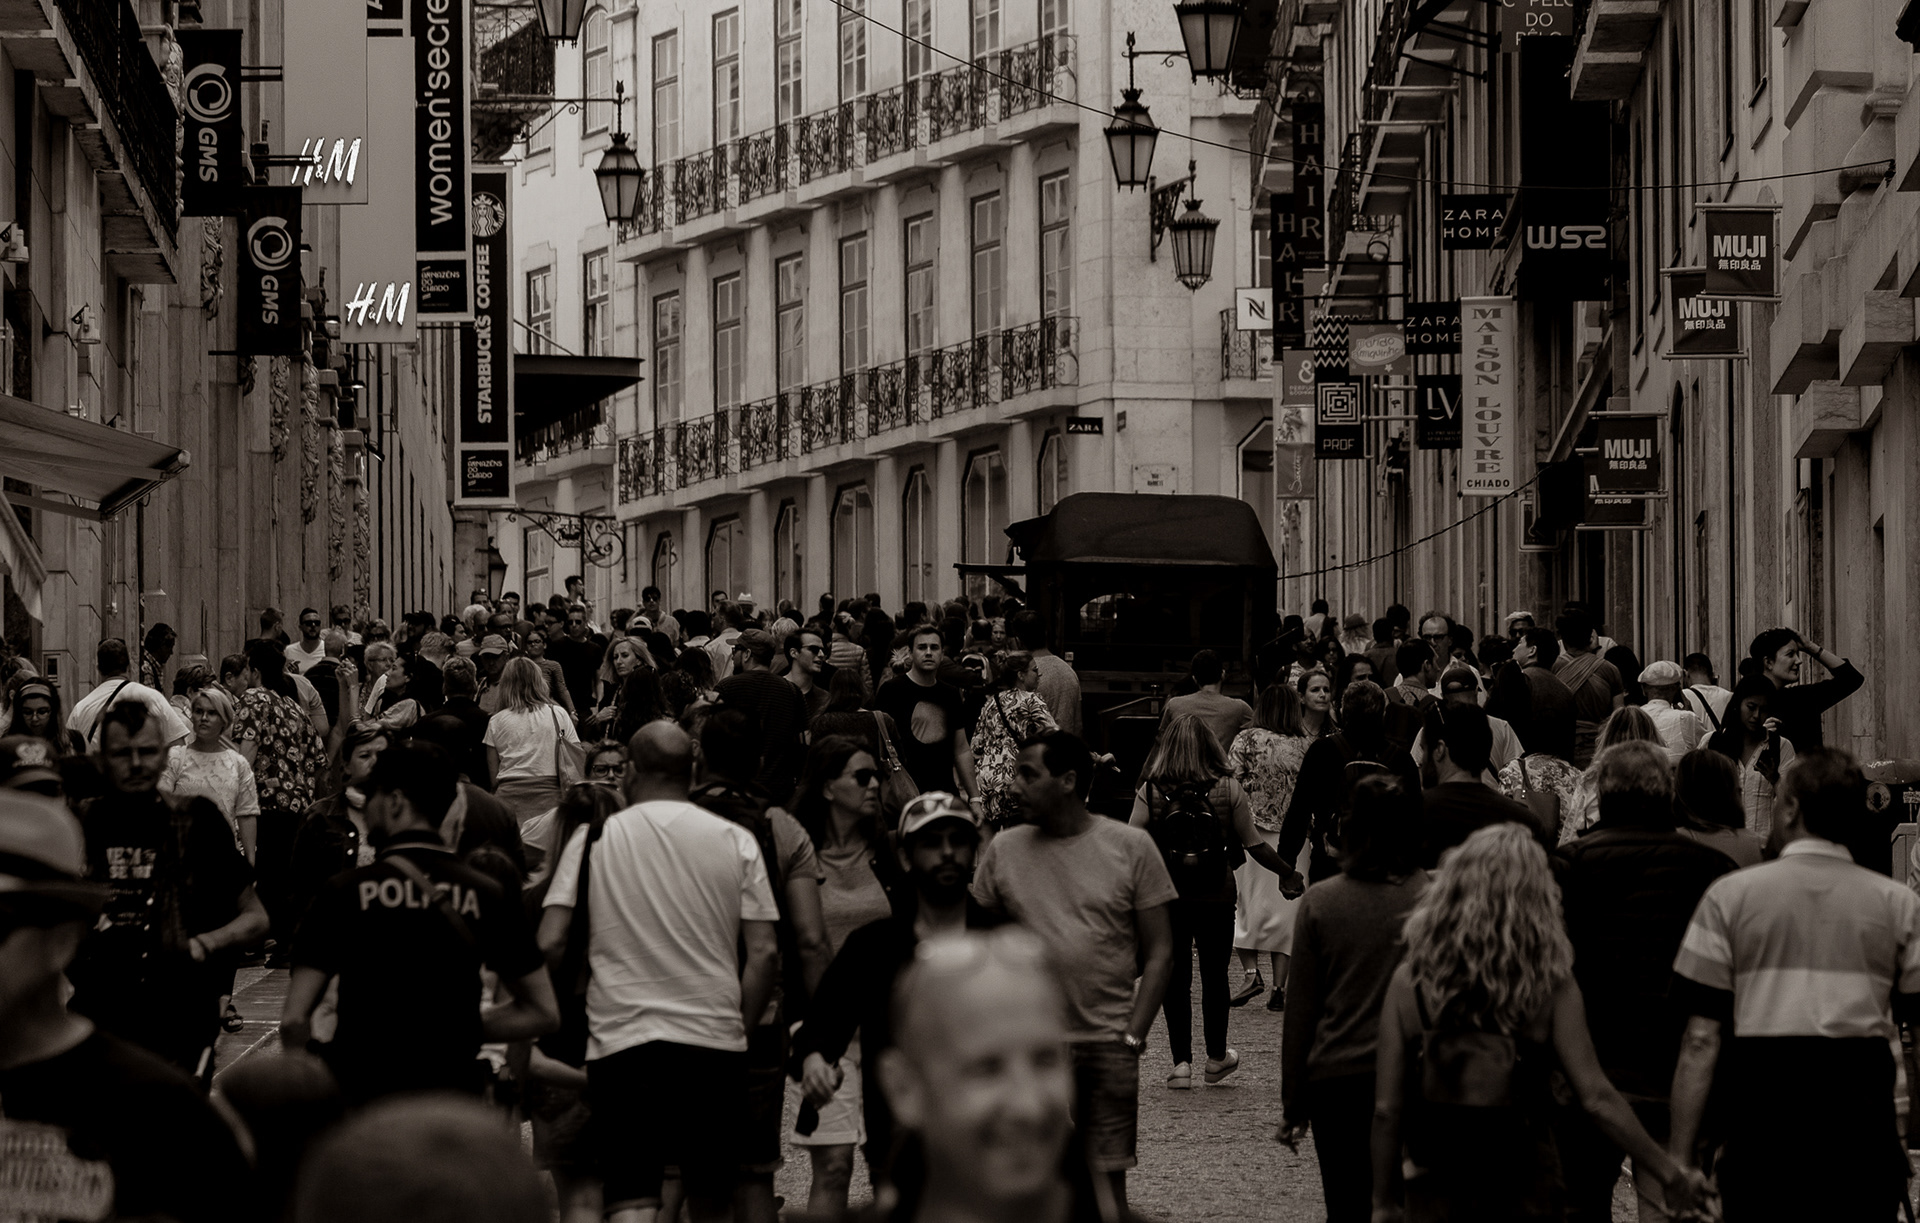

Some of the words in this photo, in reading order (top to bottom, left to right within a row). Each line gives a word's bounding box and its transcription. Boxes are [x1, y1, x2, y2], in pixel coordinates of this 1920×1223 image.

[1525, 12, 1553, 27] DO
[198, 127, 219, 183] GMS
[290, 136, 362, 187] H&M
[1298, 122, 1323, 240] HAIR
[1443, 208, 1504, 221] ZARA
[1713, 235, 1767, 258] MUJI
[475, 243, 491, 309] COFFEE
[1275, 212, 1300, 324] HAIR
[1718, 259, 1762, 271] 無印良品
[260, 274, 280, 325] GMS
[345, 281, 411, 327] H&M
[1678, 297, 1731, 319] MUJI
[1406, 316, 1462, 328] ZARA
[1684, 319, 1726, 330] 無印良品
[1406, 333, 1462, 344] HOME
[1471, 308, 1502, 385] MAISON
[477, 314, 492, 425] STARBUCKS
[1471, 396, 1504, 474] LOUVRE
[1604, 439, 1651, 459] MUJI
[1609, 460, 1647, 470] 無印良品
[1466, 479, 1510, 488] CHIADO
